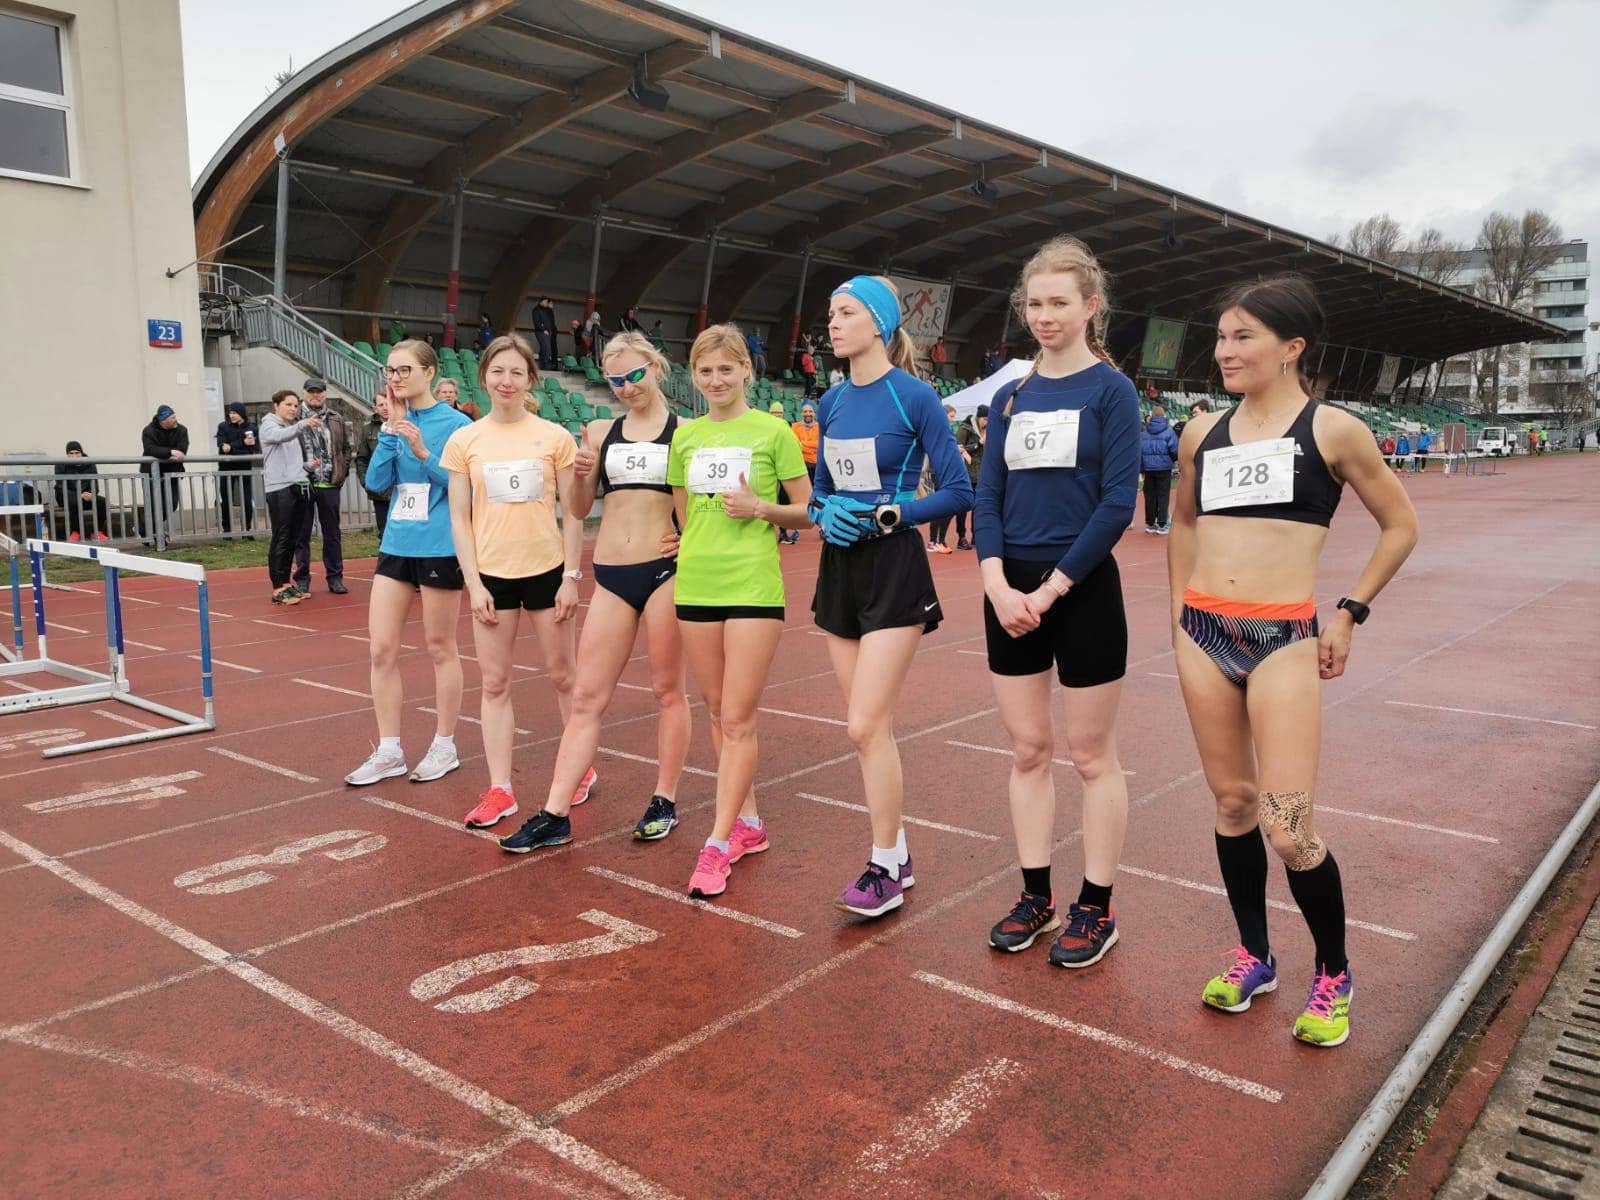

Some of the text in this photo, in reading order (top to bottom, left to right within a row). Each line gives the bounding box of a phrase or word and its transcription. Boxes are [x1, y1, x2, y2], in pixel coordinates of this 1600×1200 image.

[158, 326, 175, 341] 23
[1024, 430, 1050, 450] 67
[626, 456, 647, 470] 54
[707, 463, 728, 479] 39
[835, 458, 855, 476] 19
[509, 474, 520, 490] 6
[1224, 462, 1269, 488] 128
[173, 828, 388, 896] 3
[409, 908, 664, 1014] 2
